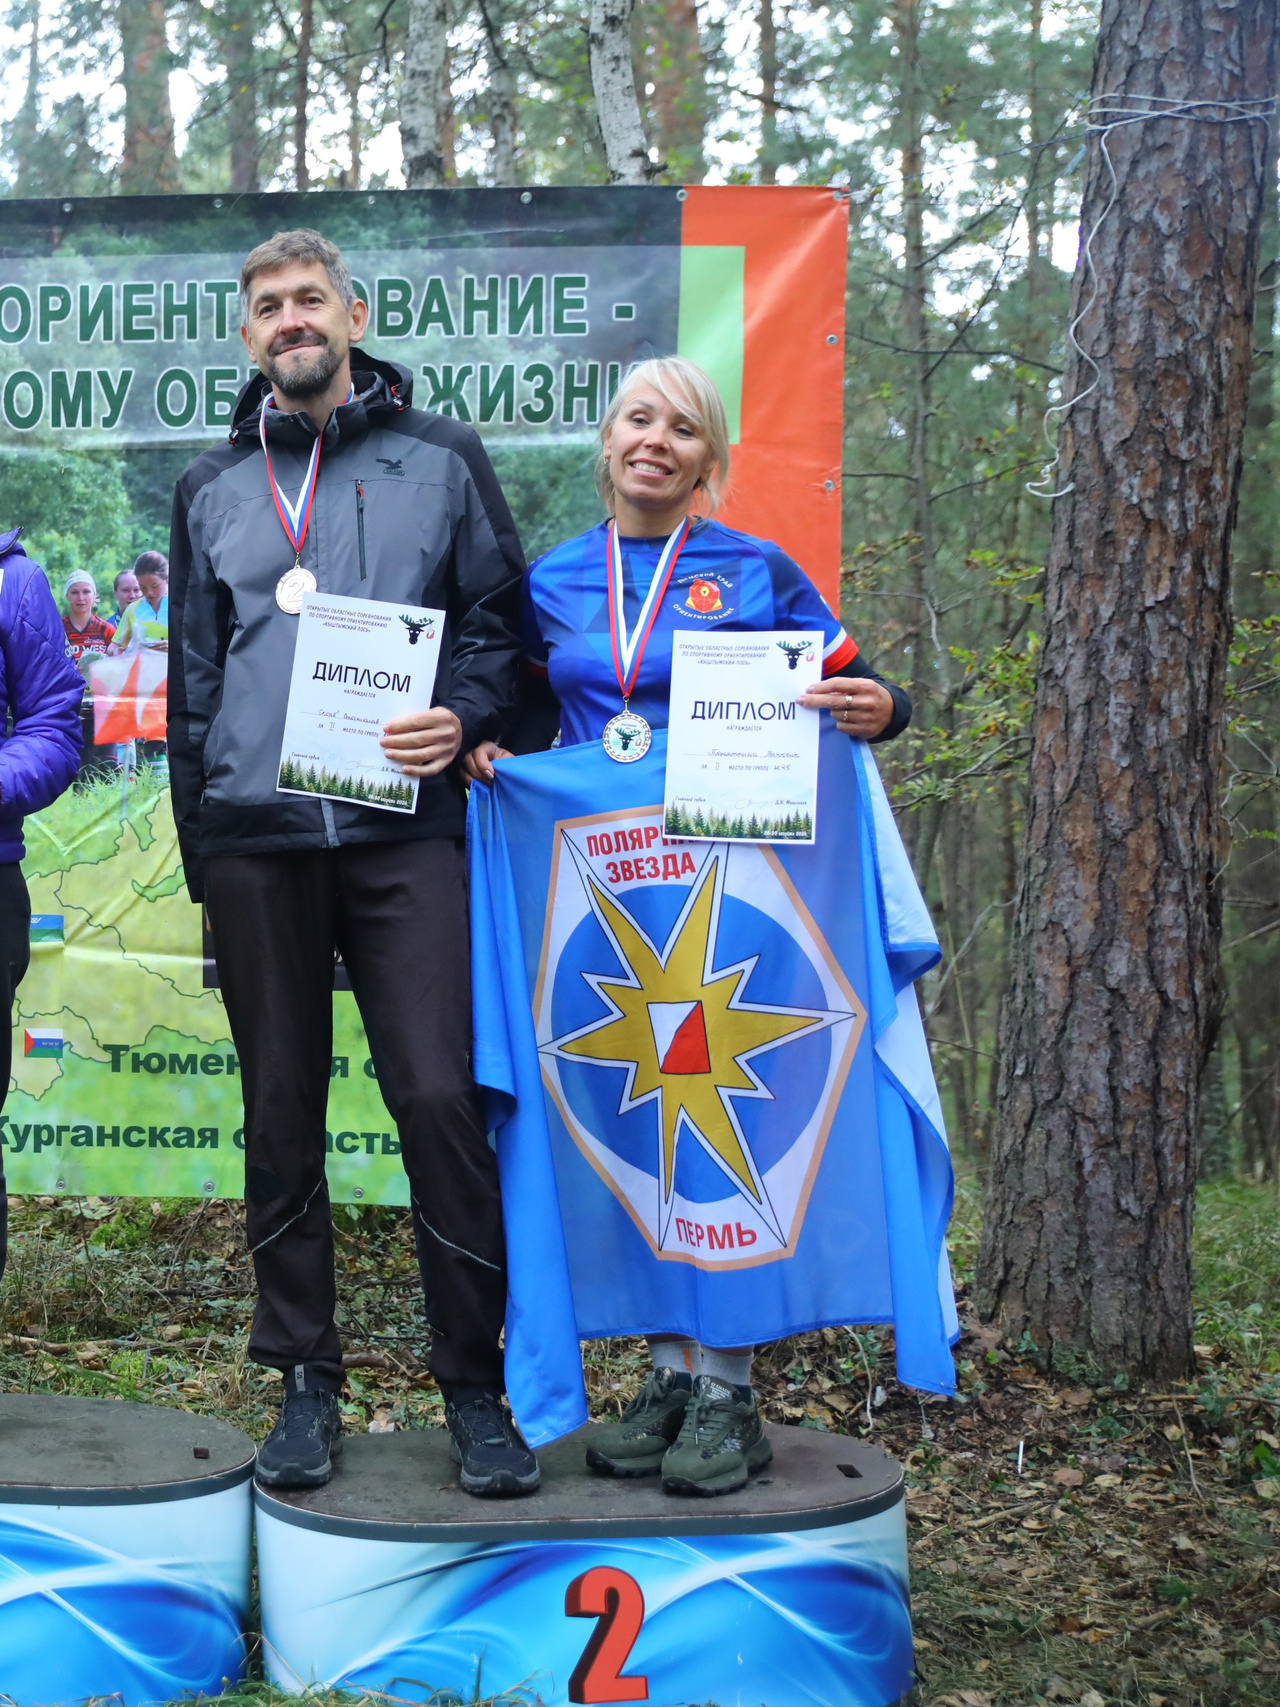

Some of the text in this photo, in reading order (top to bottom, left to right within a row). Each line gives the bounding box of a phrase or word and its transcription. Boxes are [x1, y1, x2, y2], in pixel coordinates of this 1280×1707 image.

[307, 605, 392, 621] ОТКРЫТЫЕ ОБЛАСТНЫЕ СОРЕВНОВАНИЯ
[316, 613, 346, 622] СПОРТИВНОМУ
[347, 618, 387, 628] ОРИЕНТИРОВАНИЮ
[672, 604, 734, 620] ОРИЕНТИРОВАНИЕ
[312, 661, 411, 693] ДИПЛОМ
[344, 688, 376, 698] НАГРАЖДАЕТСЯ
[691, 701, 796, 720] ДИПЛОМ
[586, 824, 692, 857] ПОЛЯР
[606, 852, 696, 884] ЗВЕЗДА
[674, 1217, 758, 1251] ПЕРМЬ
[564, 1564, 649, 1704] 2
